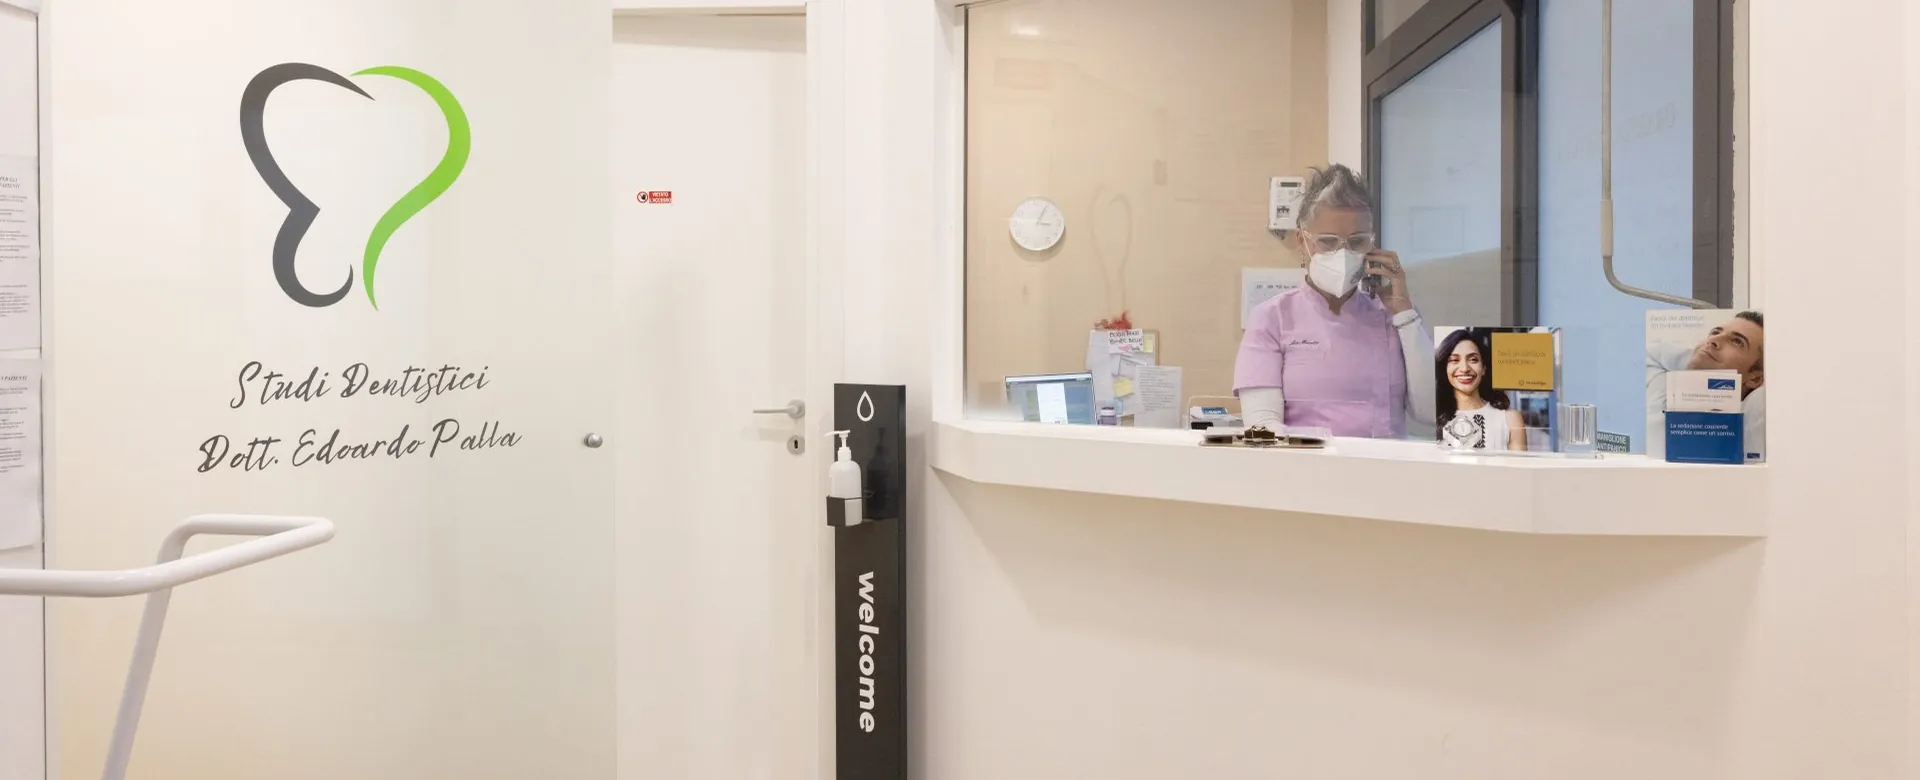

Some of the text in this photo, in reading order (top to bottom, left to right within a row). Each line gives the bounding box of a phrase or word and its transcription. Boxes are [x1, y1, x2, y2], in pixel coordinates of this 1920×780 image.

[230, 361, 490, 408] Studi Dentistici
[198, 418, 523, 472] Dott. Edoardo Palla
[858, 571, 880, 733] welcome
